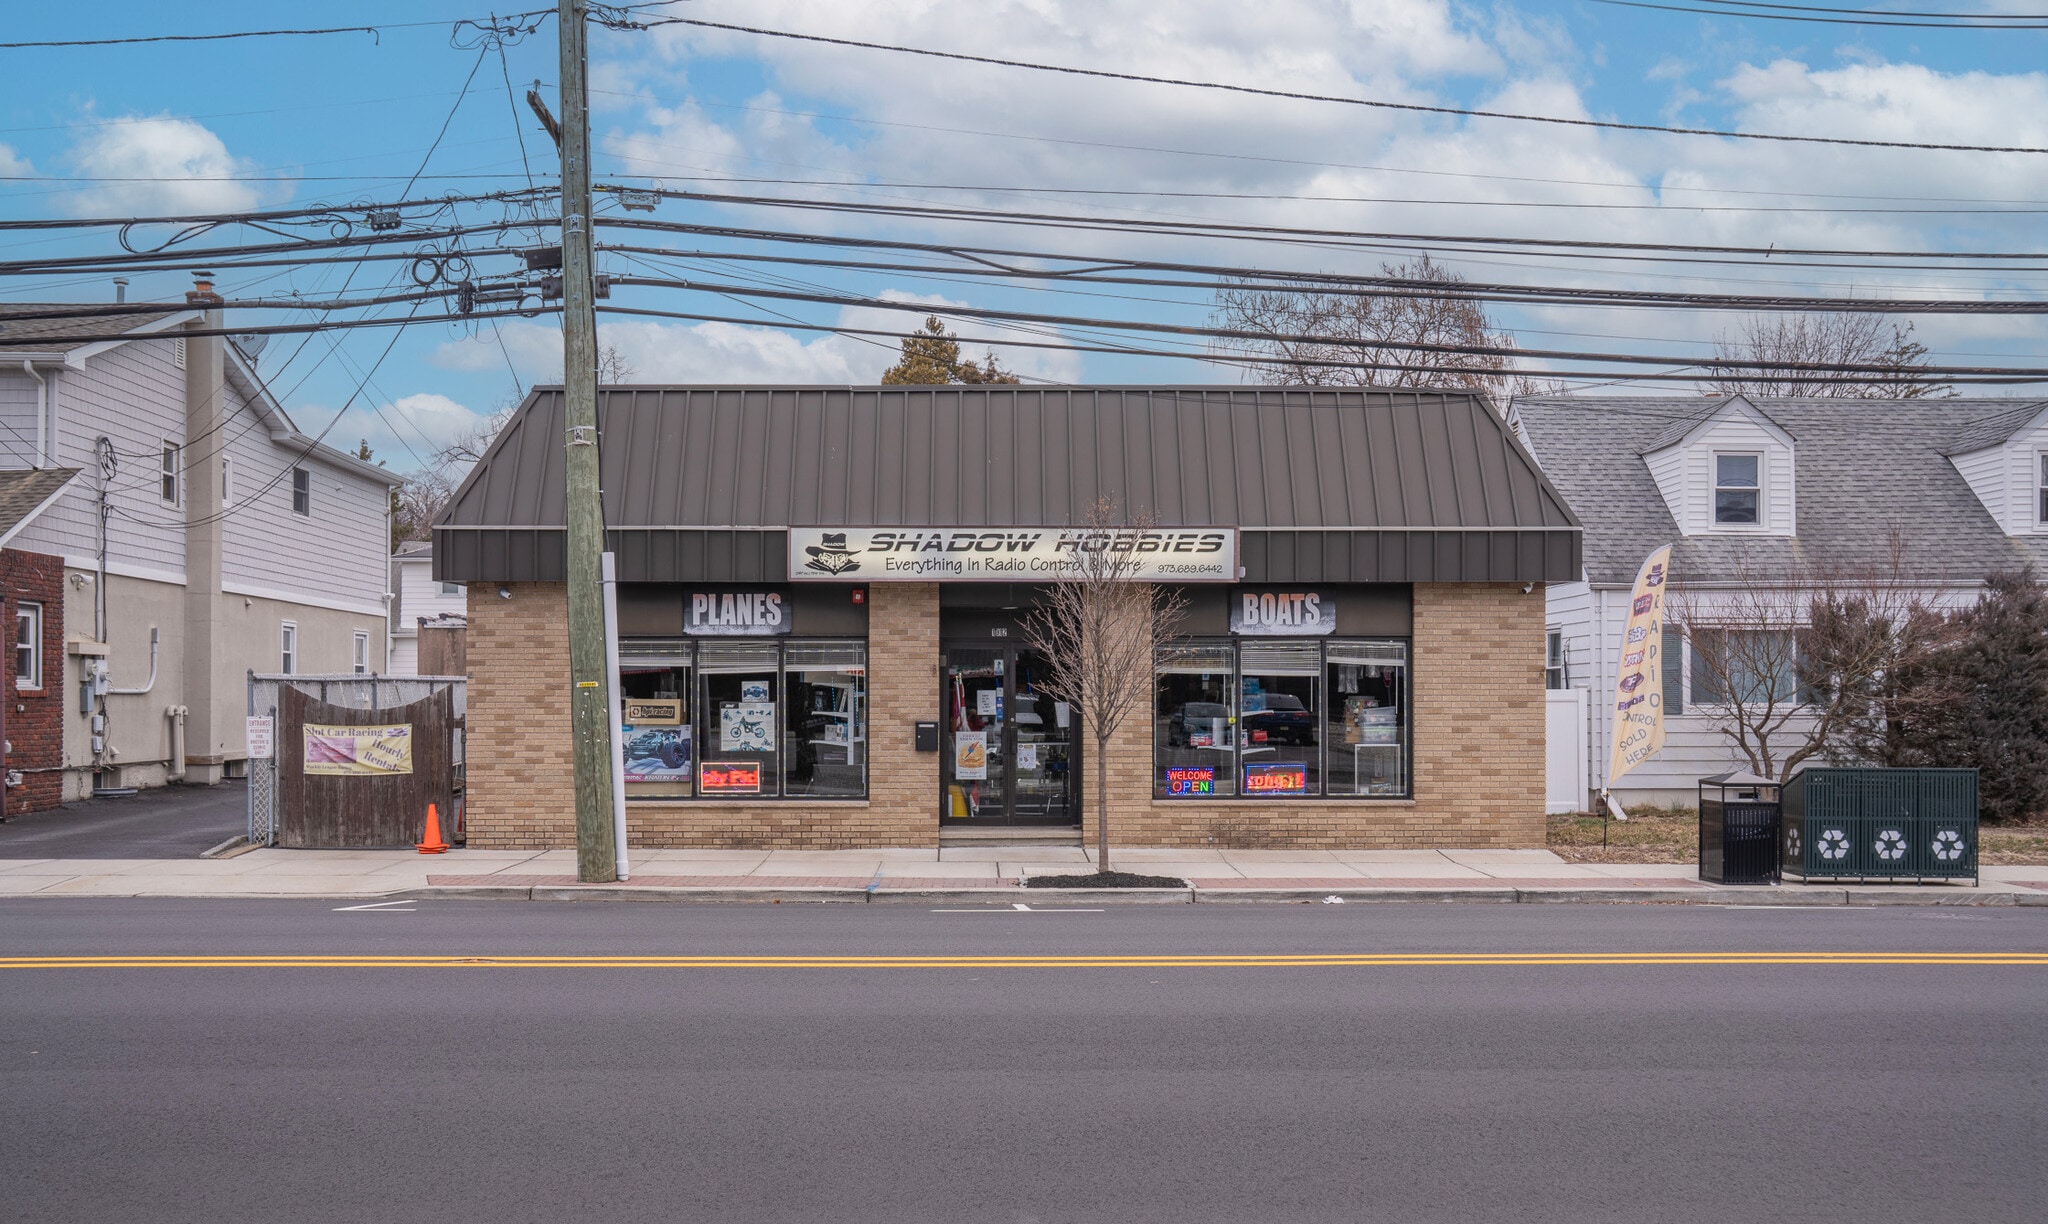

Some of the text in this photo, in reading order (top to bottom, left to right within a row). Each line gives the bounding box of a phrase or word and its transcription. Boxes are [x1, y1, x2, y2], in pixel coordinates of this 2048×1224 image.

[867, 533, 1226, 553] SHADOW HOBBIES
[885, 557, 963, 575] Everything
[967, 557, 980, 571] In
[984, 557, 1026, 571] Radio
[1104, 559, 1142, 571] More
[1157, 564, 1223, 574] 973.689.6442
[692, 592, 782, 626] PLANES
[1242, 592, 1321, 626] BOATS
[249, 719, 271, 727] ENTRANCE
[305, 726, 384, 738] Slot Car Racing
[371, 738, 404, 761] Hourly
[1619, 728, 1648, 752] SOLD
[1624, 742, 1654, 765] HERE
[1169, 770, 1213, 780] WELCOME
[1172, 780, 1209, 792] OPEN
